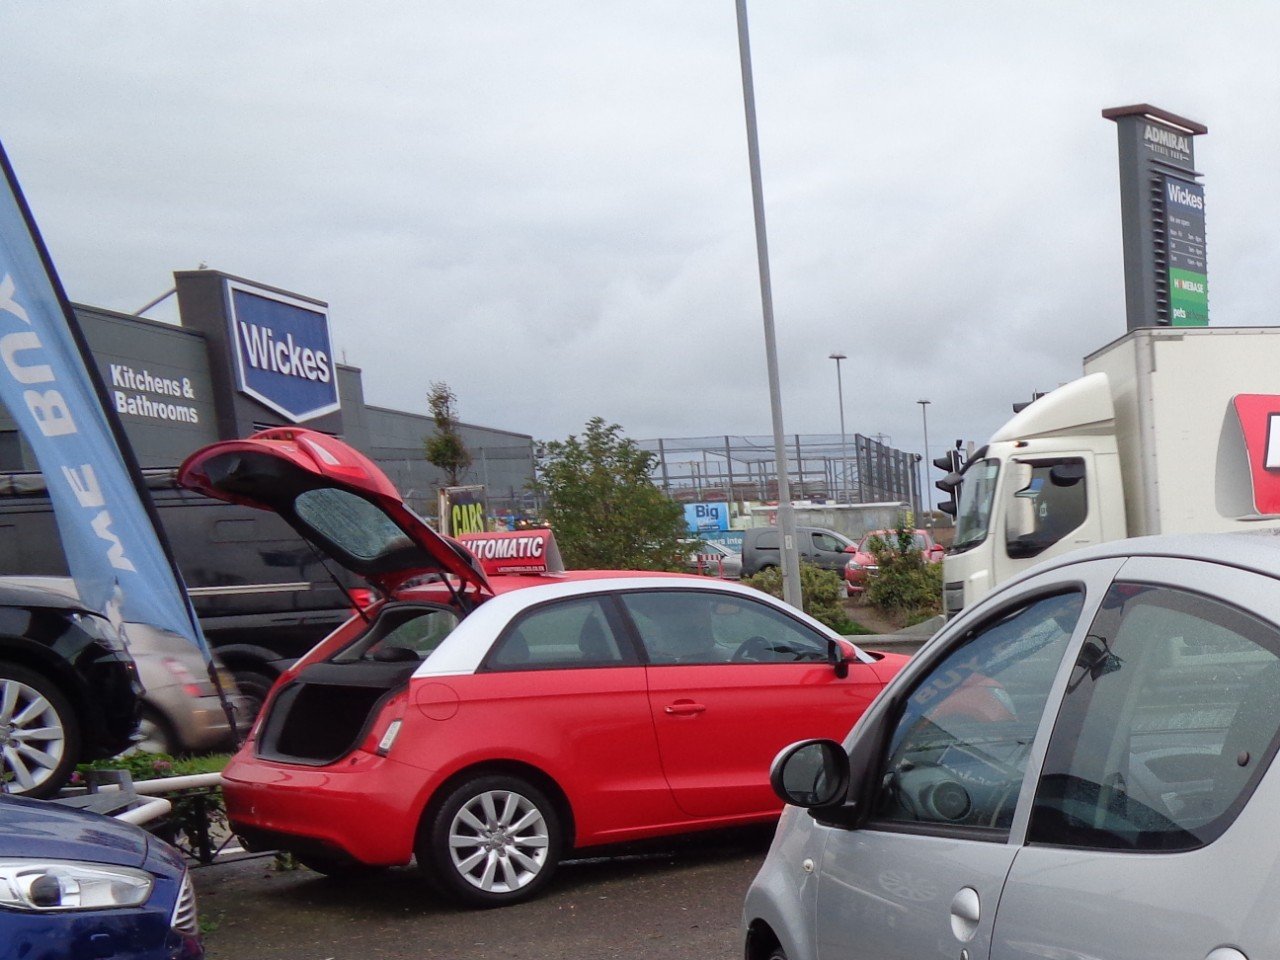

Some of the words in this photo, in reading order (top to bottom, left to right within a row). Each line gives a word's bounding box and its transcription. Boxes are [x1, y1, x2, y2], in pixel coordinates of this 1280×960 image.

[1144, 125, 1190, 154] ADMIRAL
[1167, 183, 1203, 210] Wickes
[1173, 307, 1187, 319] pets
[241, 321, 330, 383] Wickes
[110, 364, 181, 397] Kitchens
[182, 377, 195, 399] &
[114, 391, 199, 424] Bathrooms
[452, 502, 484, 539] CARS
[695, 504, 719, 520] Big
